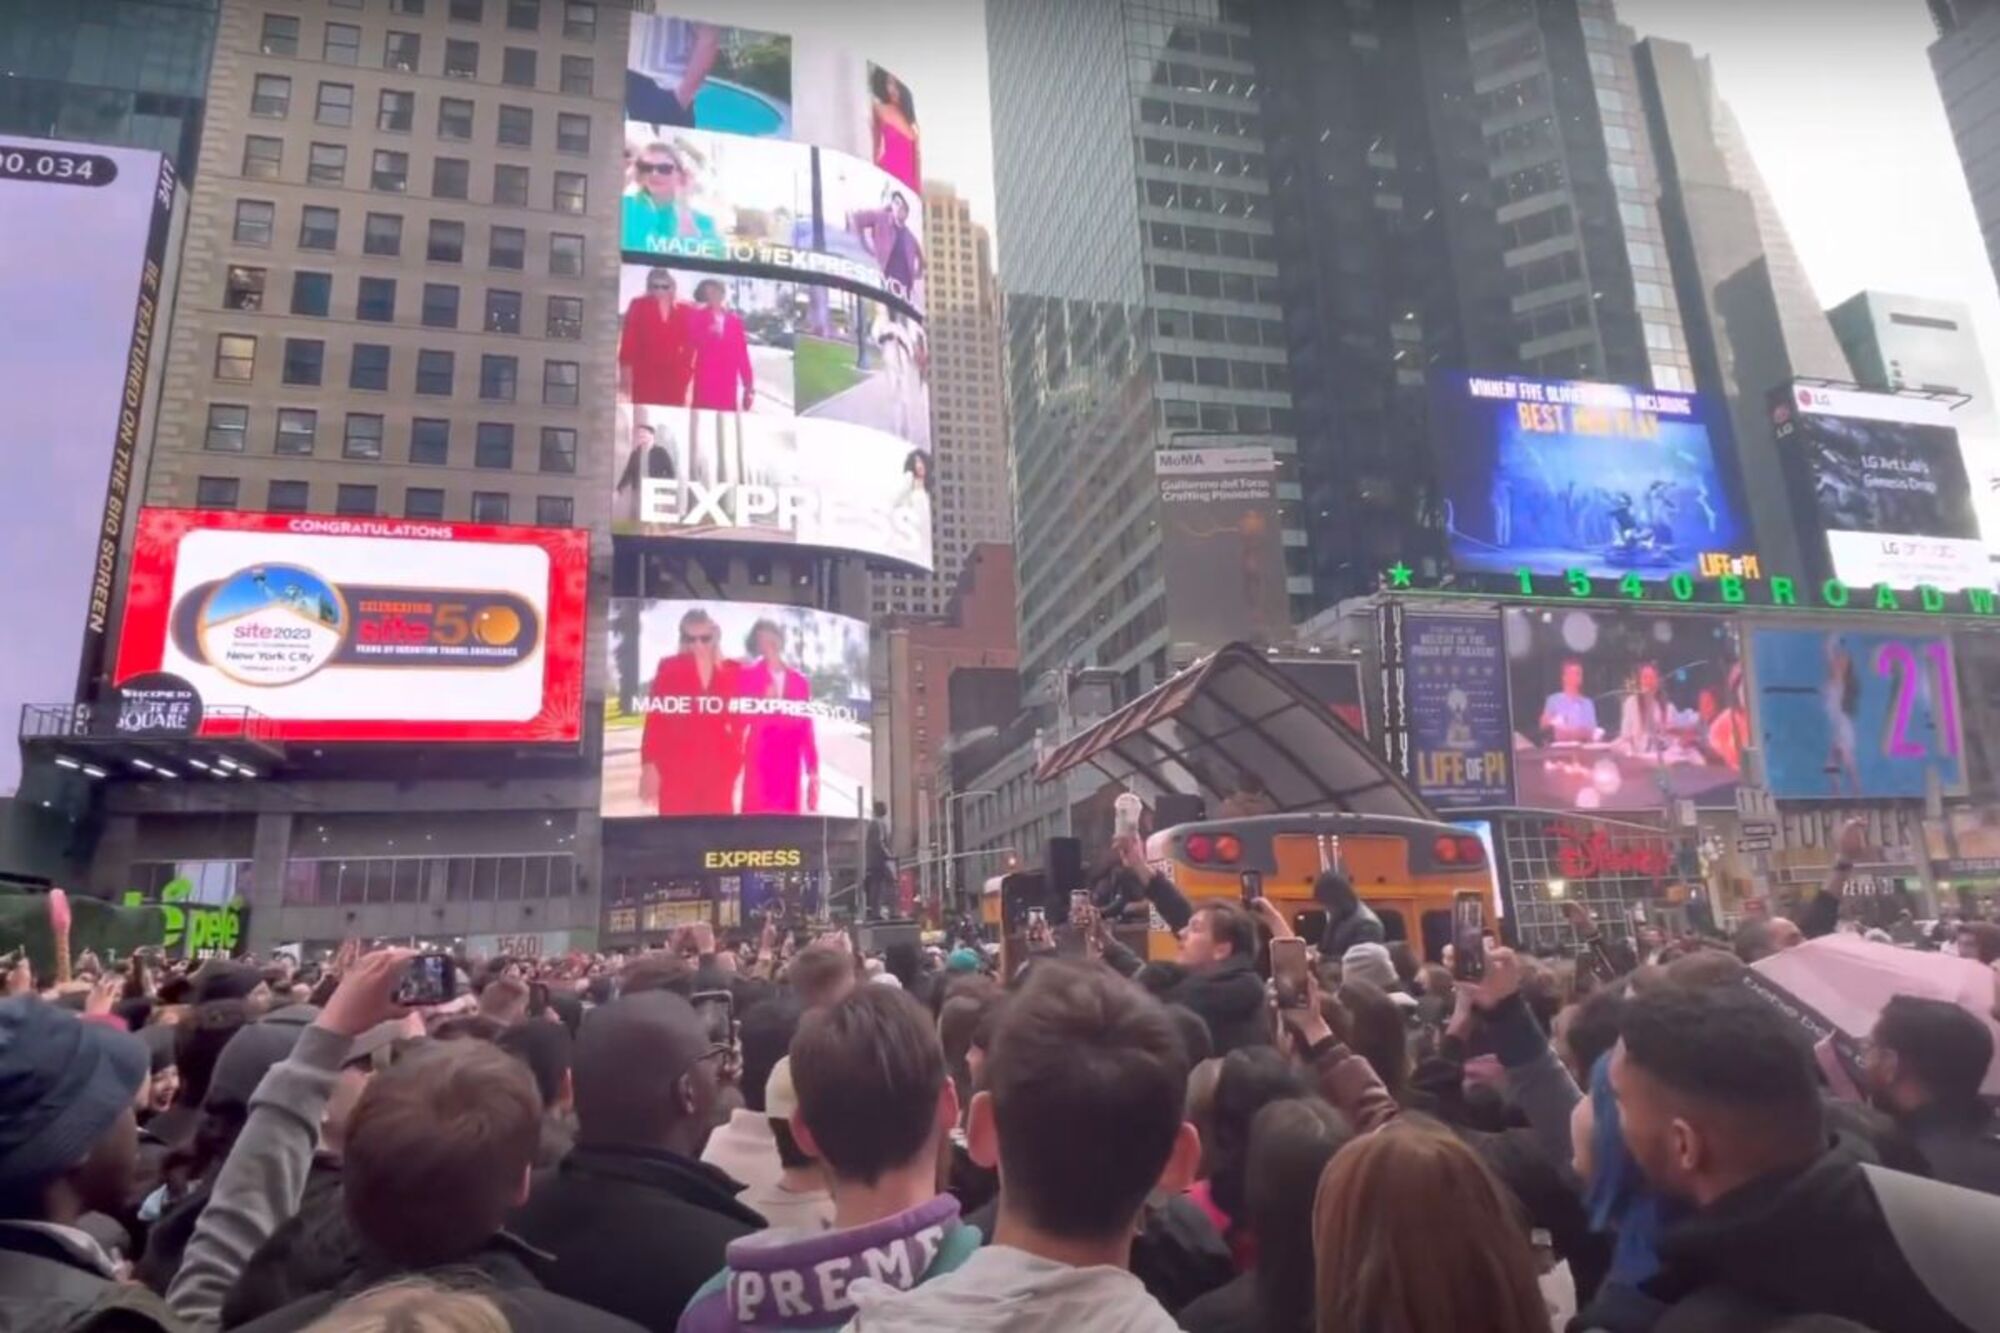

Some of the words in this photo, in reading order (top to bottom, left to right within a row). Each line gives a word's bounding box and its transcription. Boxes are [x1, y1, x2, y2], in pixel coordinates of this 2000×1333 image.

[0, 152, 94, 180] 0.034
[645, 234, 713, 258] MADE
[125, 293, 154, 408] FEATURED
[1813, 394, 1831, 407] LG
[120, 409, 135, 445] ON
[1516, 402, 1565, 433] BEST
[112, 447, 130, 497] THE
[1160, 455, 1203, 467] MoMA
[105, 497, 123, 536] BIG
[288, 518, 454, 540] CONGRATULATIONS
[1511, 566, 1694, 601] 1540
[631, 695, 692, 715] MADE
[698, 696, 724, 714] TO
[1874, 640, 1962, 759] 21
[1417, 751, 1465, 787] LIFE
[1484, 751, 1508, 787] PI
[705, 850, 800, 868] EXPRESS
